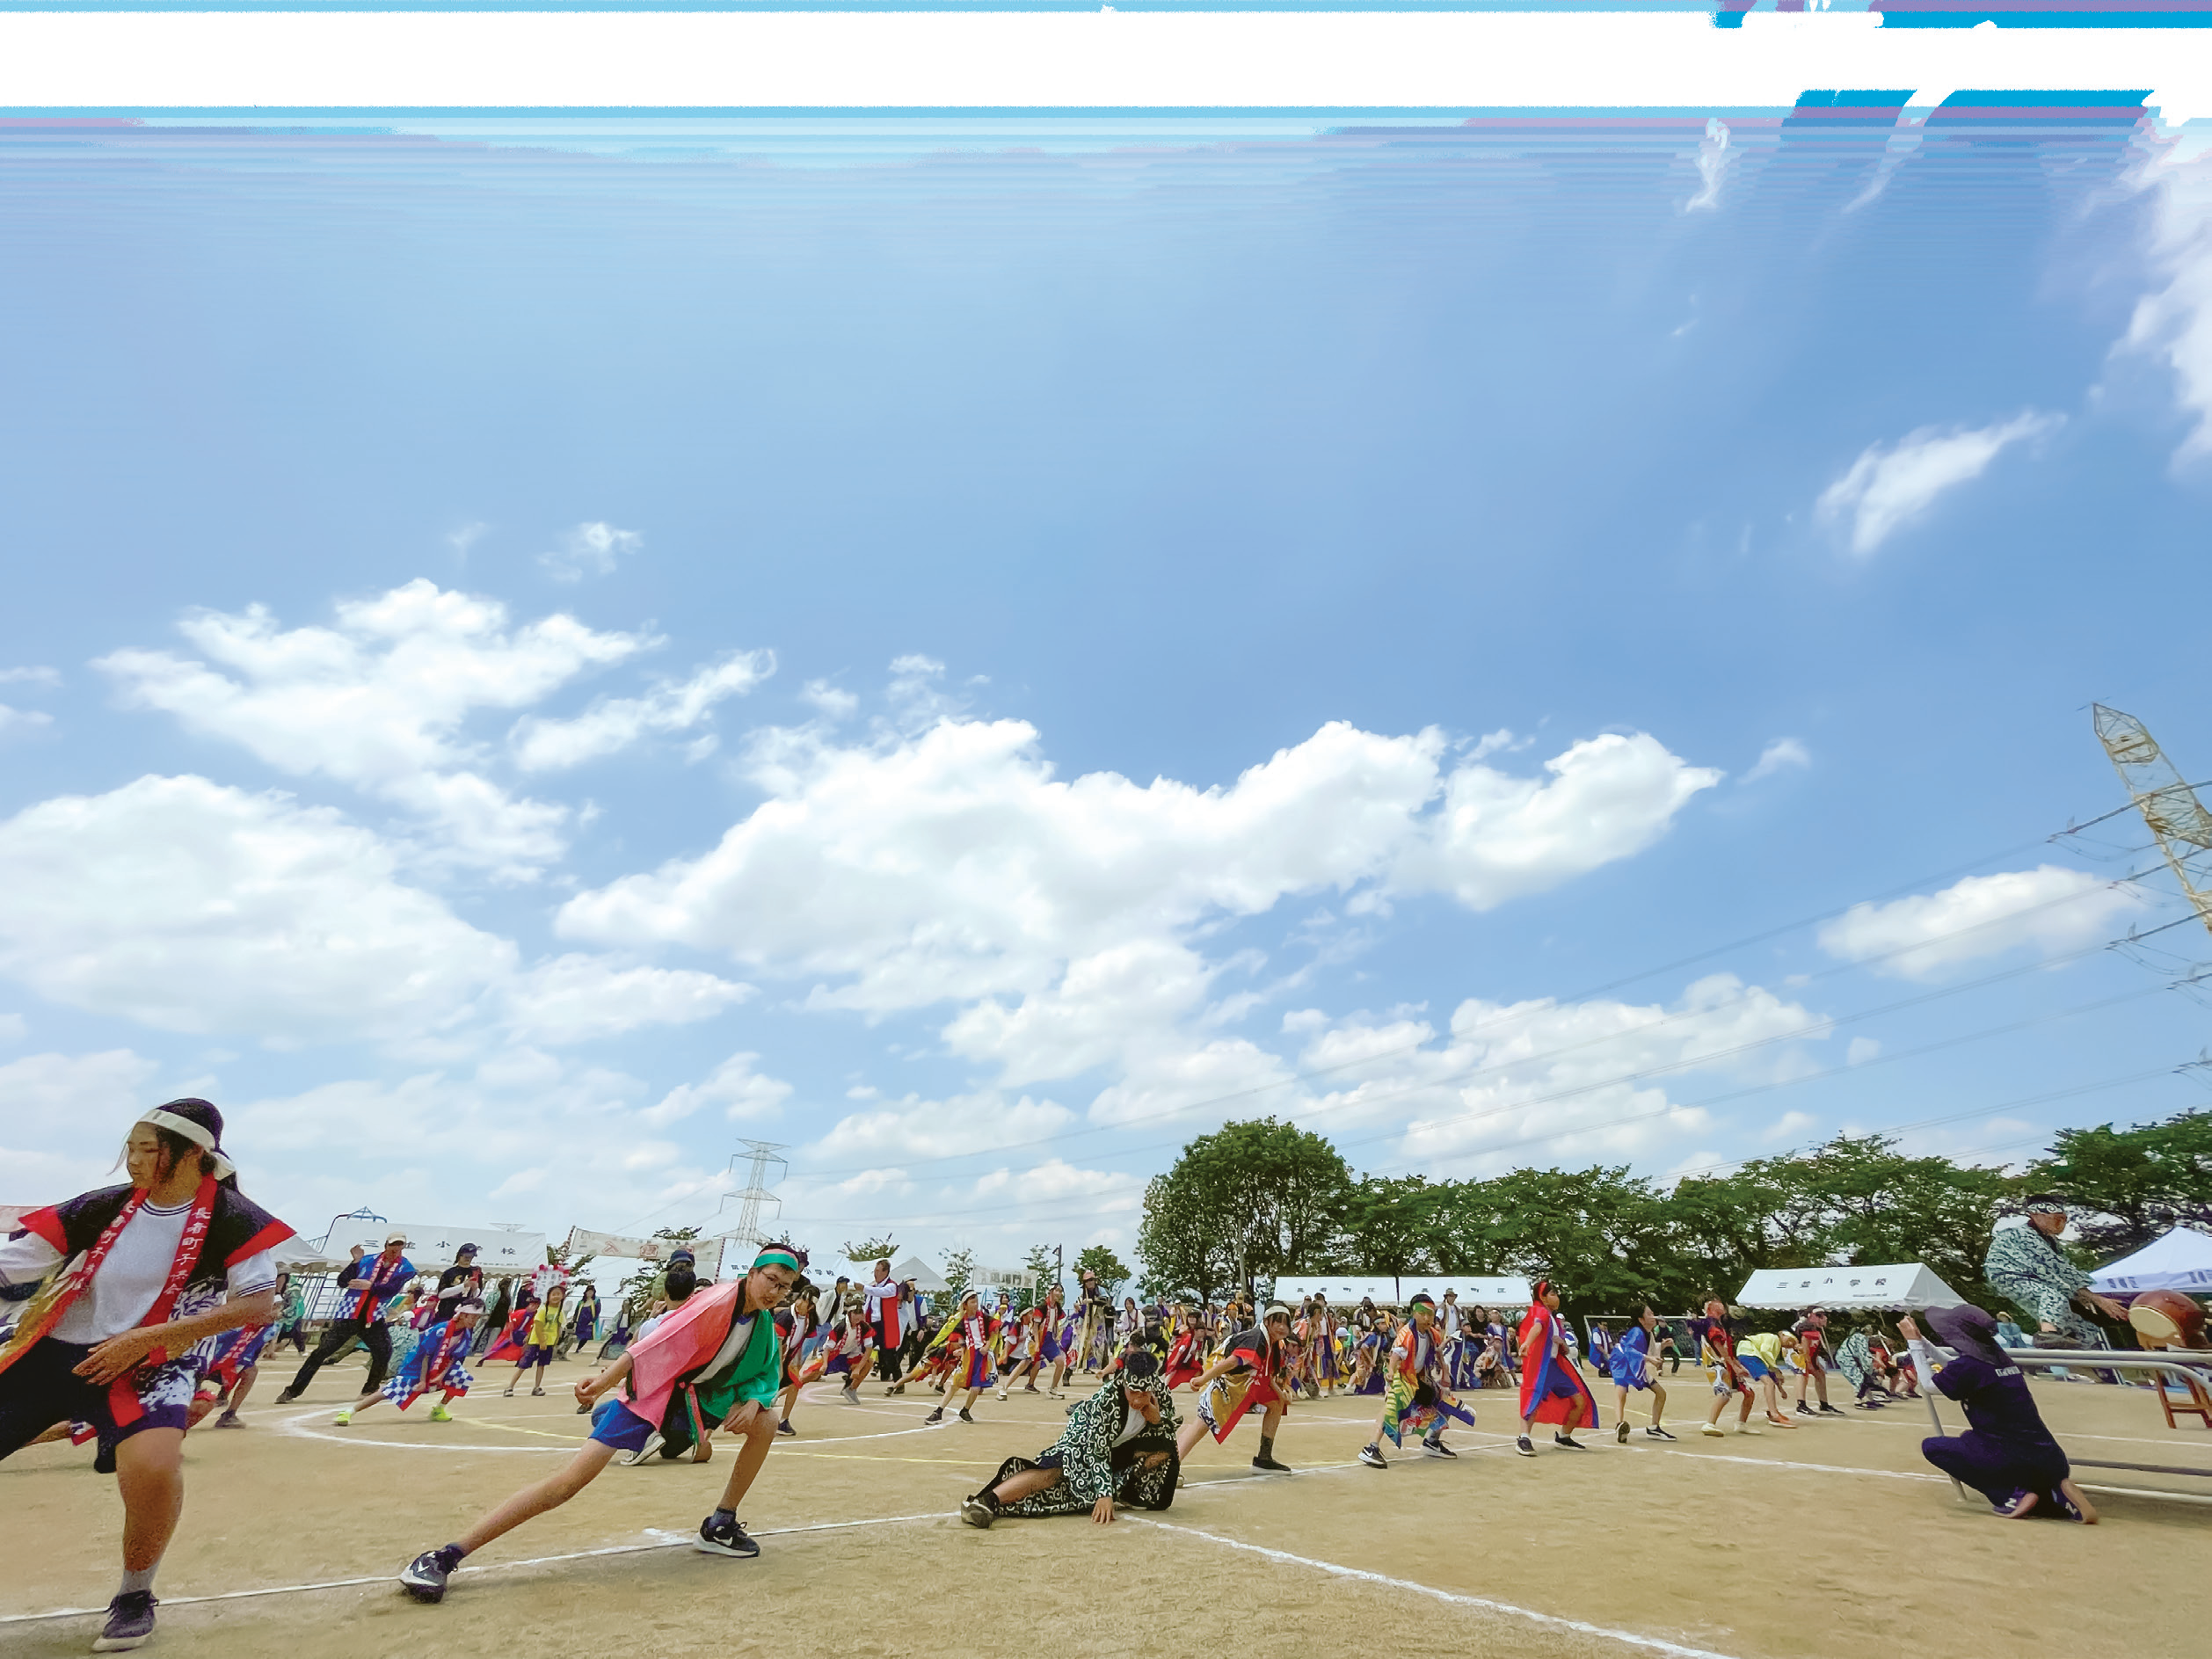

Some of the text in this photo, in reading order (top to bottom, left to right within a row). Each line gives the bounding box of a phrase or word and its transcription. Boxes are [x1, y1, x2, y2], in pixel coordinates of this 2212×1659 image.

[164, 1207, 211, 1295] 長者町子供会
